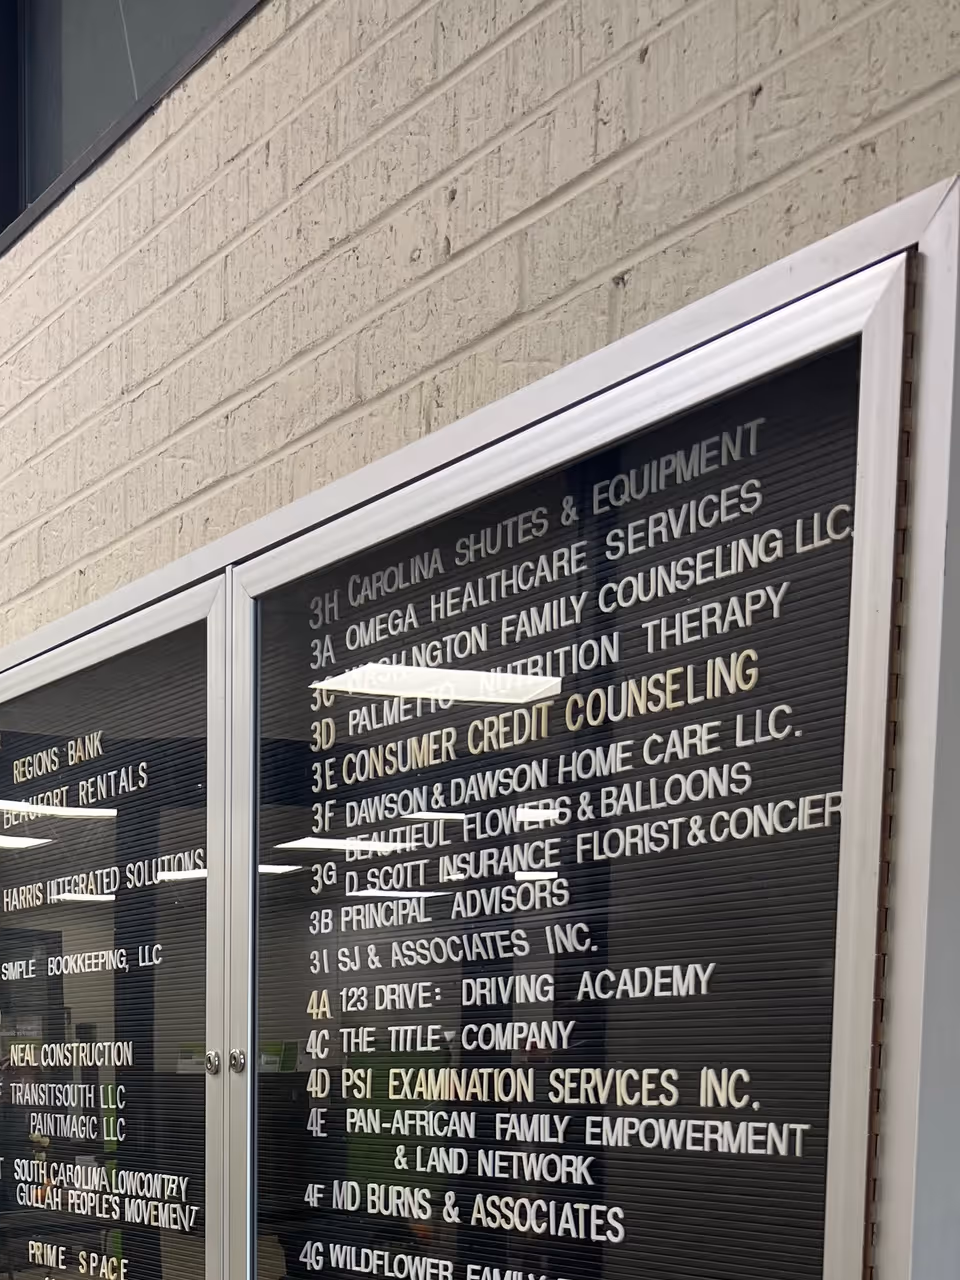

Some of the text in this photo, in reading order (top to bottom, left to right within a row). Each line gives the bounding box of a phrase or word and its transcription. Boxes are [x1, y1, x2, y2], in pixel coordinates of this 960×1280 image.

[309, 417, 766, 630] 3H CAROLINA SHUTES & EQUIPMENT
[310, 479, 762, 670] 3A OMEGA HEALTHCARE SERVICES
[310, 676, 335, 711] 3C
[501, 591, 589, 645] FAMILY
[599, 529, 783, 613] COUNSELING
[310, 717, 336, 752] 3D
[642, 581, 790, 653] THERAPY
[311, 649, 759, 793] 3E CONSUMER CREDIT COUNSELING
[13, 730, 104, 784] REGIONS BANK
[311, 704, 802, 833] 3F DAWSON & DAWSON HOME CARE LLC.
[79, 762, 148, 806] RENTALS
[345, 762, 752, 862] BEAUTIFUL FLOWERS & BALLOONS
[4, 883, 43, 912] HARRIS
[47, 866, 120, 903] INTEGRATED
[126, 848, 205, 888] SOLUTIONS
[310, 861, 337, 895] 3G
[367, 858, 430, 891] SCOTT
[439, 838, 562, 883] INSURANCE
[309, 878, 570, 935] 3B PRINCIPAL ADVISORS
[1, 959, 36, 981] SIMPLE
[48, 948, 129, 976] BOOKKEEPING,
[139, 944, 162, 967] LLC
[338, 946, 361, 972] SJ
[367, 944, 382, 969] &
[391, 929, 530, 968] ASSOCIATES
[545, 922, 598, 954] INC.
[306, 963, 716, 1020] 4A 123 DRIVE: DRIVING ACADEMY
[10, 1044, 39, 1066] NEAL
[41, 1041, 133, 1067] CONSTRUCTION
[306, 1020, 576, 1059] 4C THE TITLE COMPANY
[10, 1083, 95, 1108] TRANSITSOUTH
[100, 1085, 126, 1108] LLC
[306, 1066, 761, 1111] 4D PSI EXAMINATION SERVICES INC.
[30, 1112, 126, 1141] PAINTMAGIC LLC
[307, 1108, 811, 1157] 4E PAN-AFRICAN FAMILY EMPOWERMENT
[14, 1159, 47, 1184] SOUTH
[50, 1162, 110, 1193] CAROLINA
[394, 1145, 595, 1186] & LAND NETWORK
[16, 1183, 200, 1232] GULLAH PEOPLE'S MOVEMENT
[304, 1179, 625, 1244] 4F MD BURNS & ASSOCIATES
[28, 1240, 66, 1269] PRIME
[299, 1241, 324, 1271] 4G
